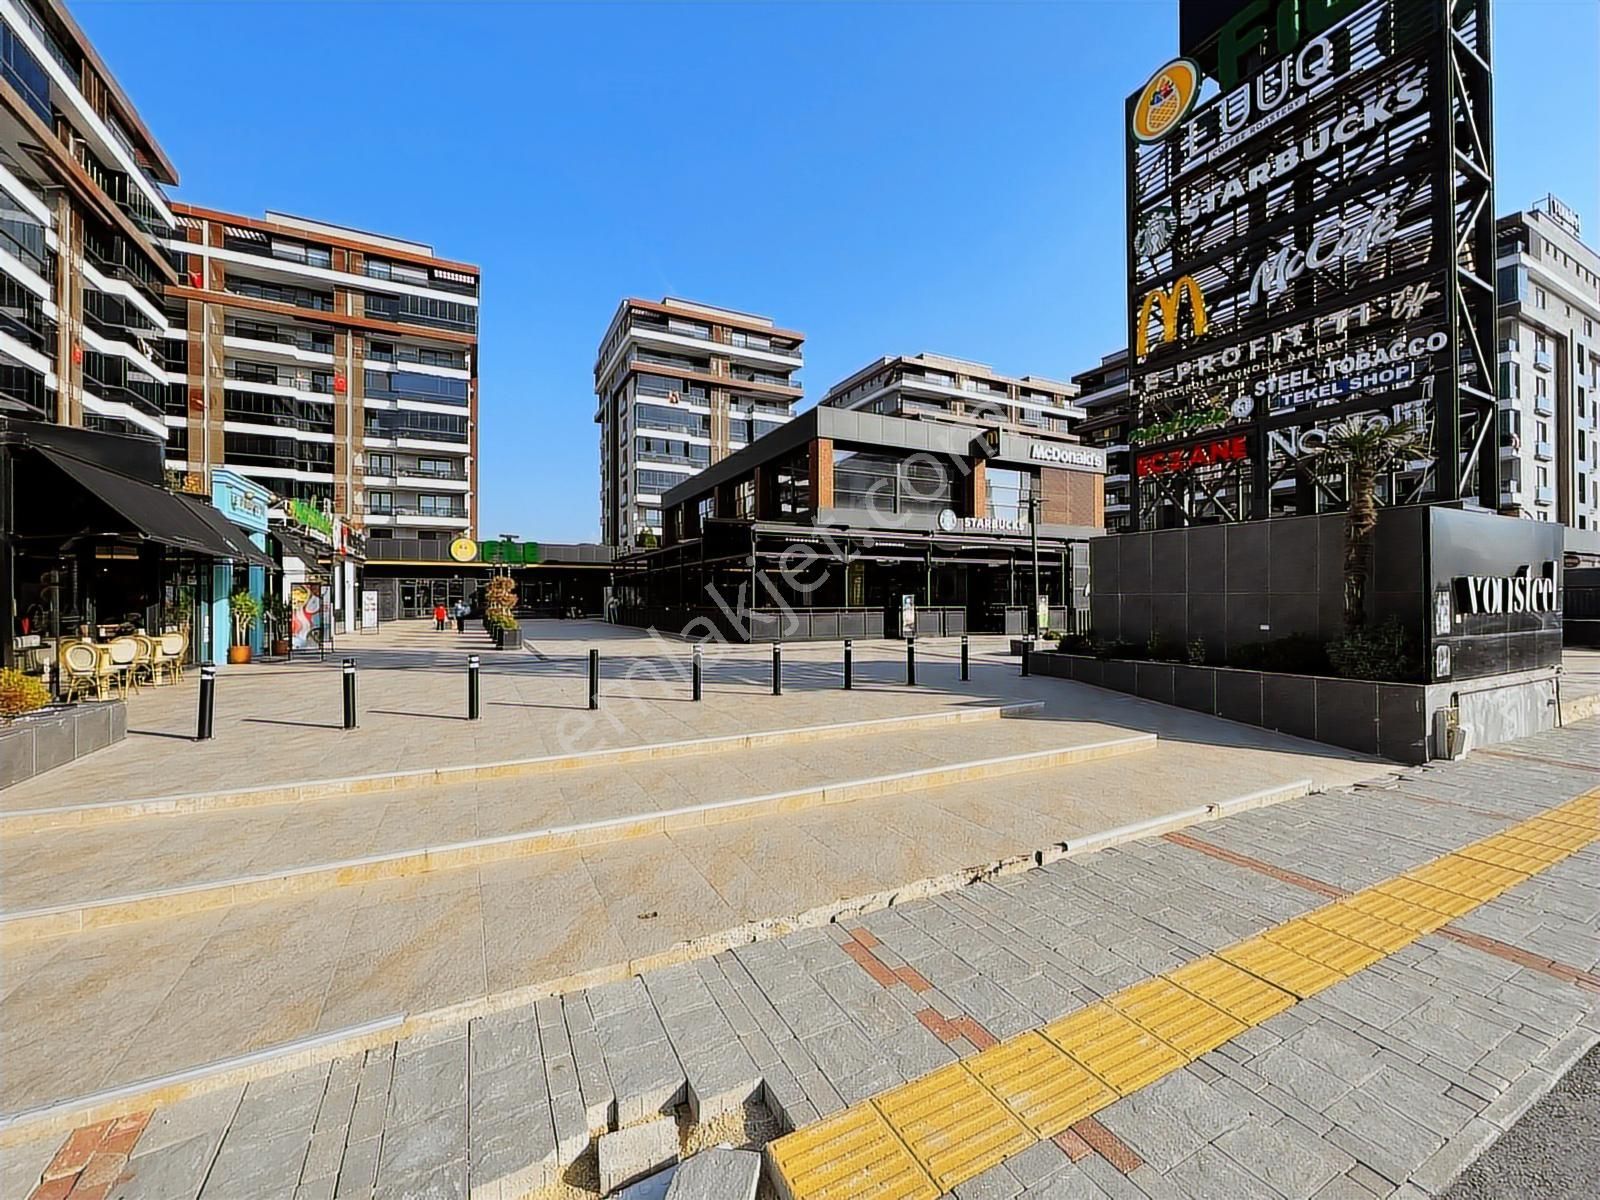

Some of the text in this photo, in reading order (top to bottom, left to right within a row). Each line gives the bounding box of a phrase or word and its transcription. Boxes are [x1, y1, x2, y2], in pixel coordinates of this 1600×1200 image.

[1182, 77, 1425, 225] STARBUCKS
[1254, 331, 1448, 396] STEEL TOBACCO
[1281, 365, 1410, 405] TEKEL SHOP
[1032, 444, 1103, 467] McDonald's
[964, 516, 1026, 531] STARBUCKS
[1467, 560, 1558, 614] vonsteel
